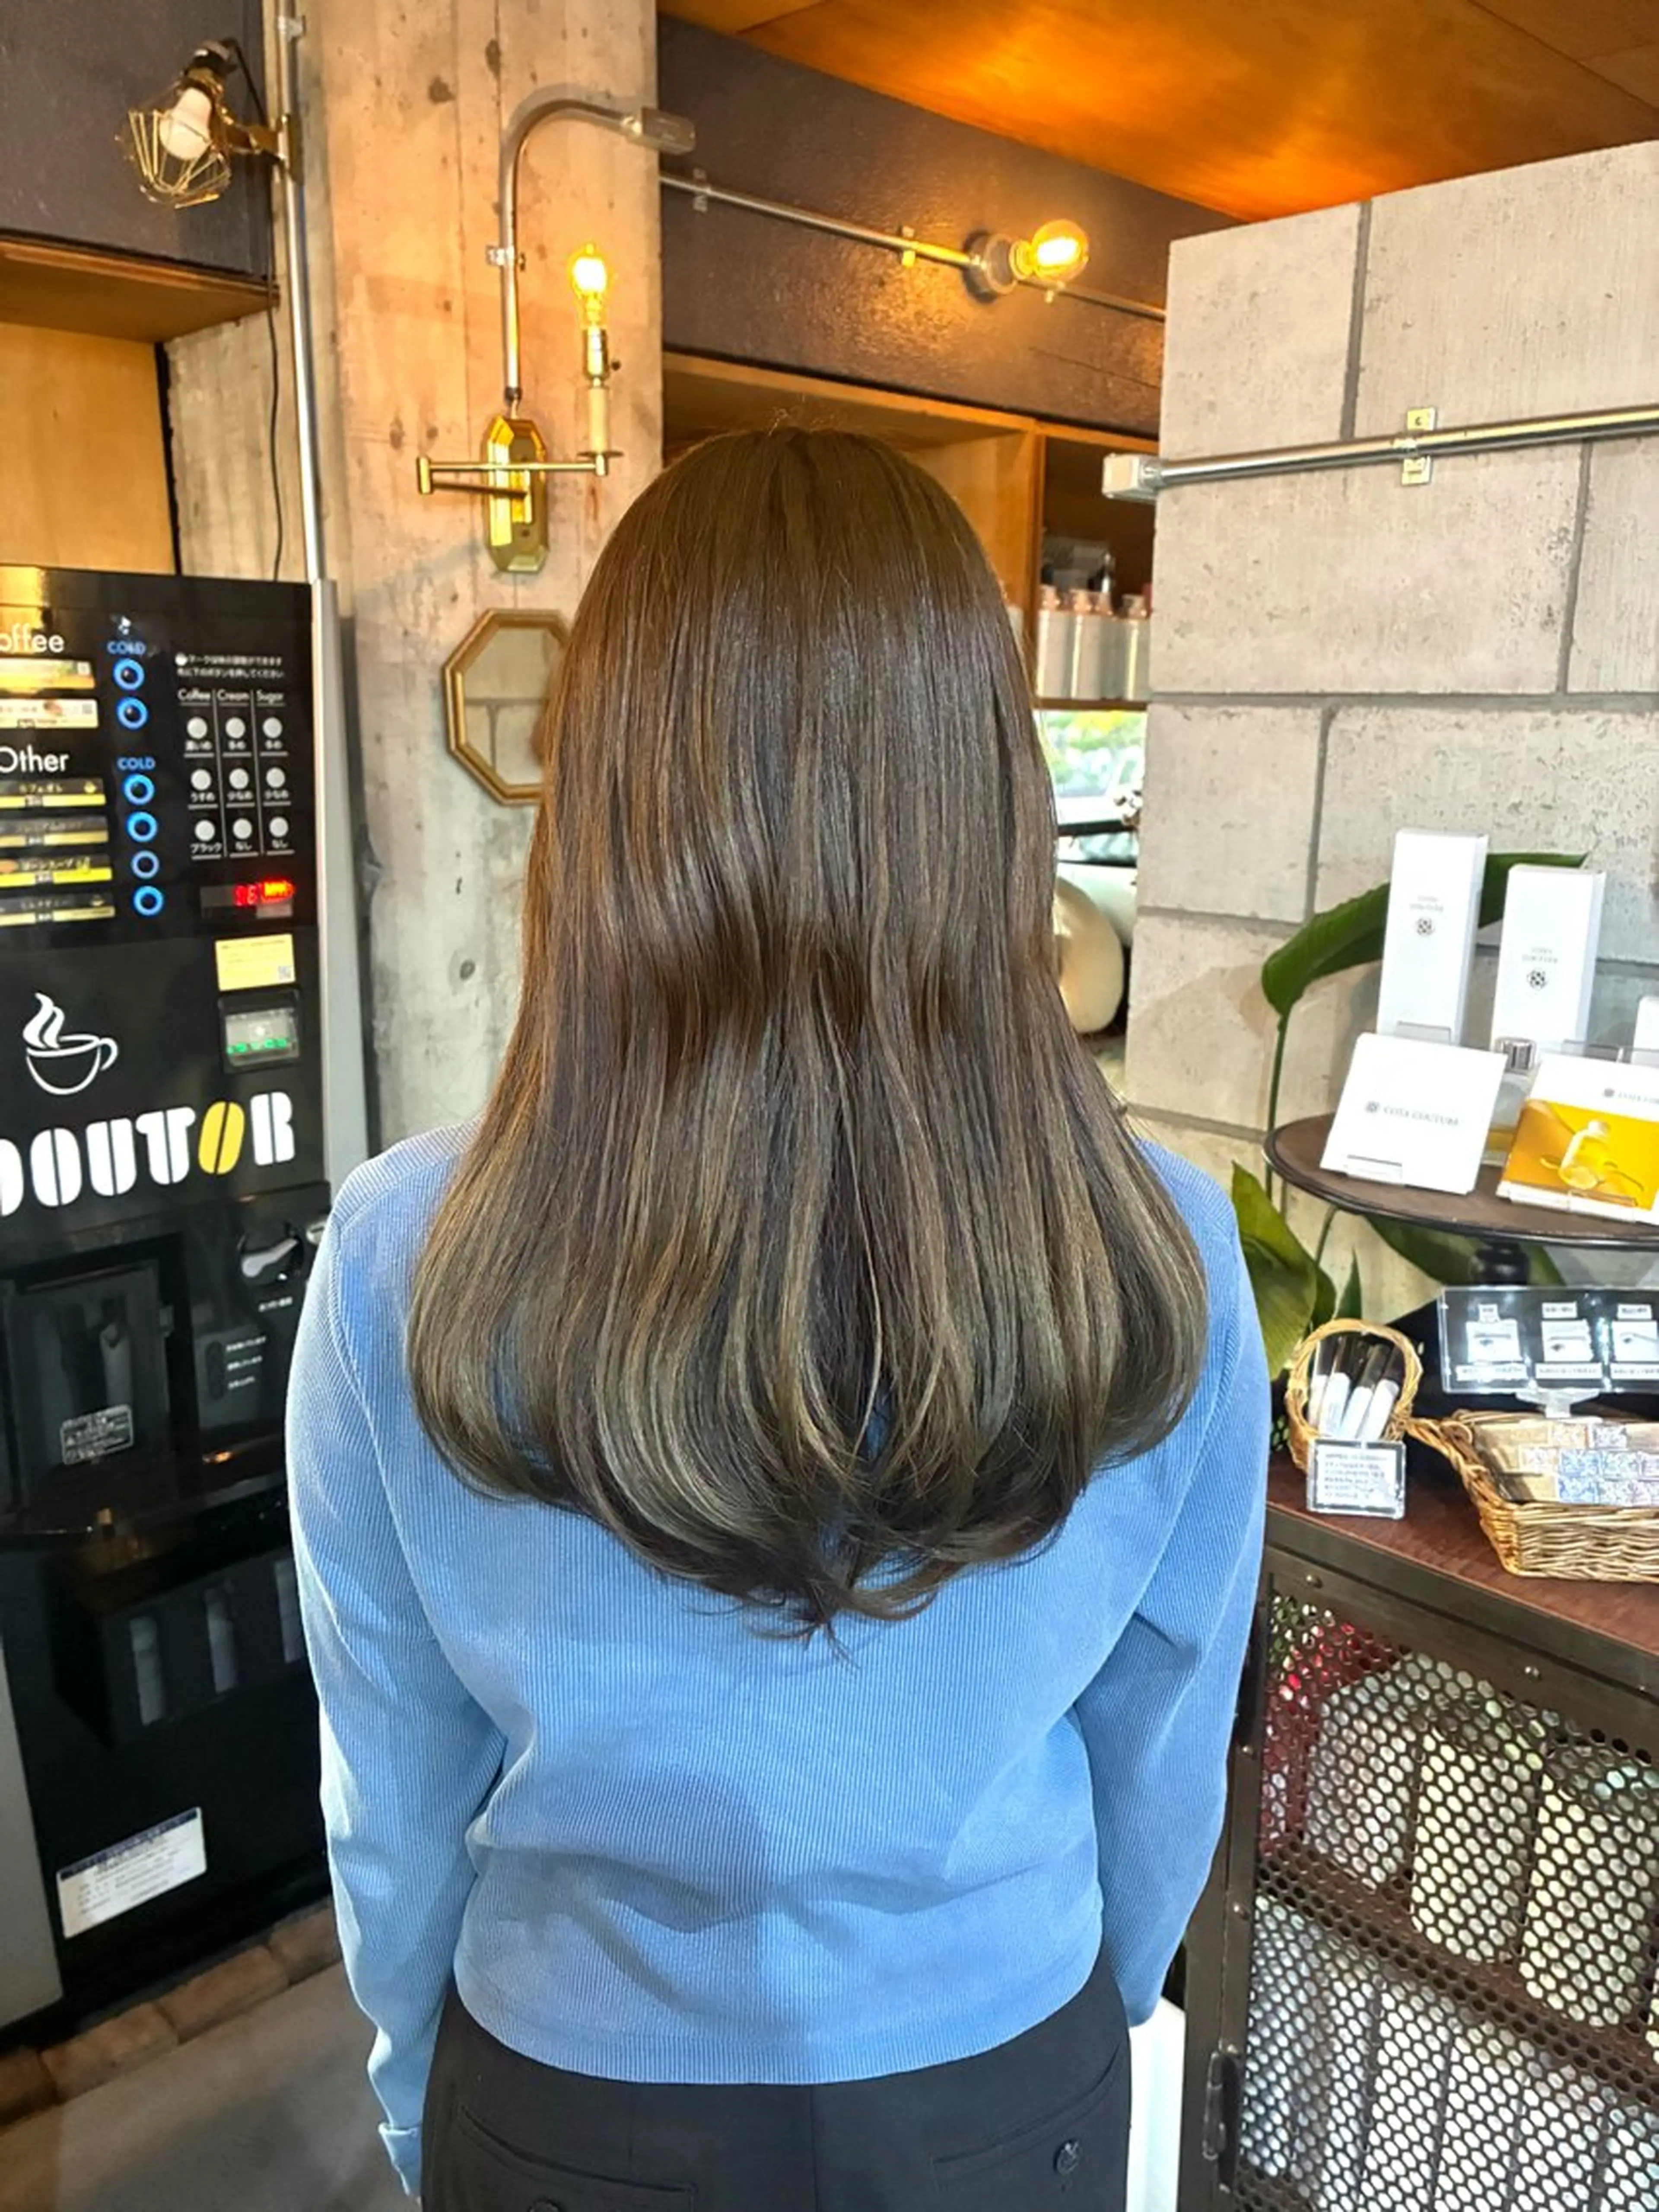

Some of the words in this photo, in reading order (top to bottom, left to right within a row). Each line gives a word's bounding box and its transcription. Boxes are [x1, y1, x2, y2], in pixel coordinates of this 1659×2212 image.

[107, 641, 146, 655] COLD
[177, 689, 211, 701] Coffee
[217, 689, 249, 701] Cream
[256, 690, 283, 705] Sugar
[0, 744, 69, 773] Other
[117, 757, 156, 770] COLD
[190, 842, 222, 853] ブラック
[235, 842, 252, 850] なし
[272, 839, 288, 848] なし
